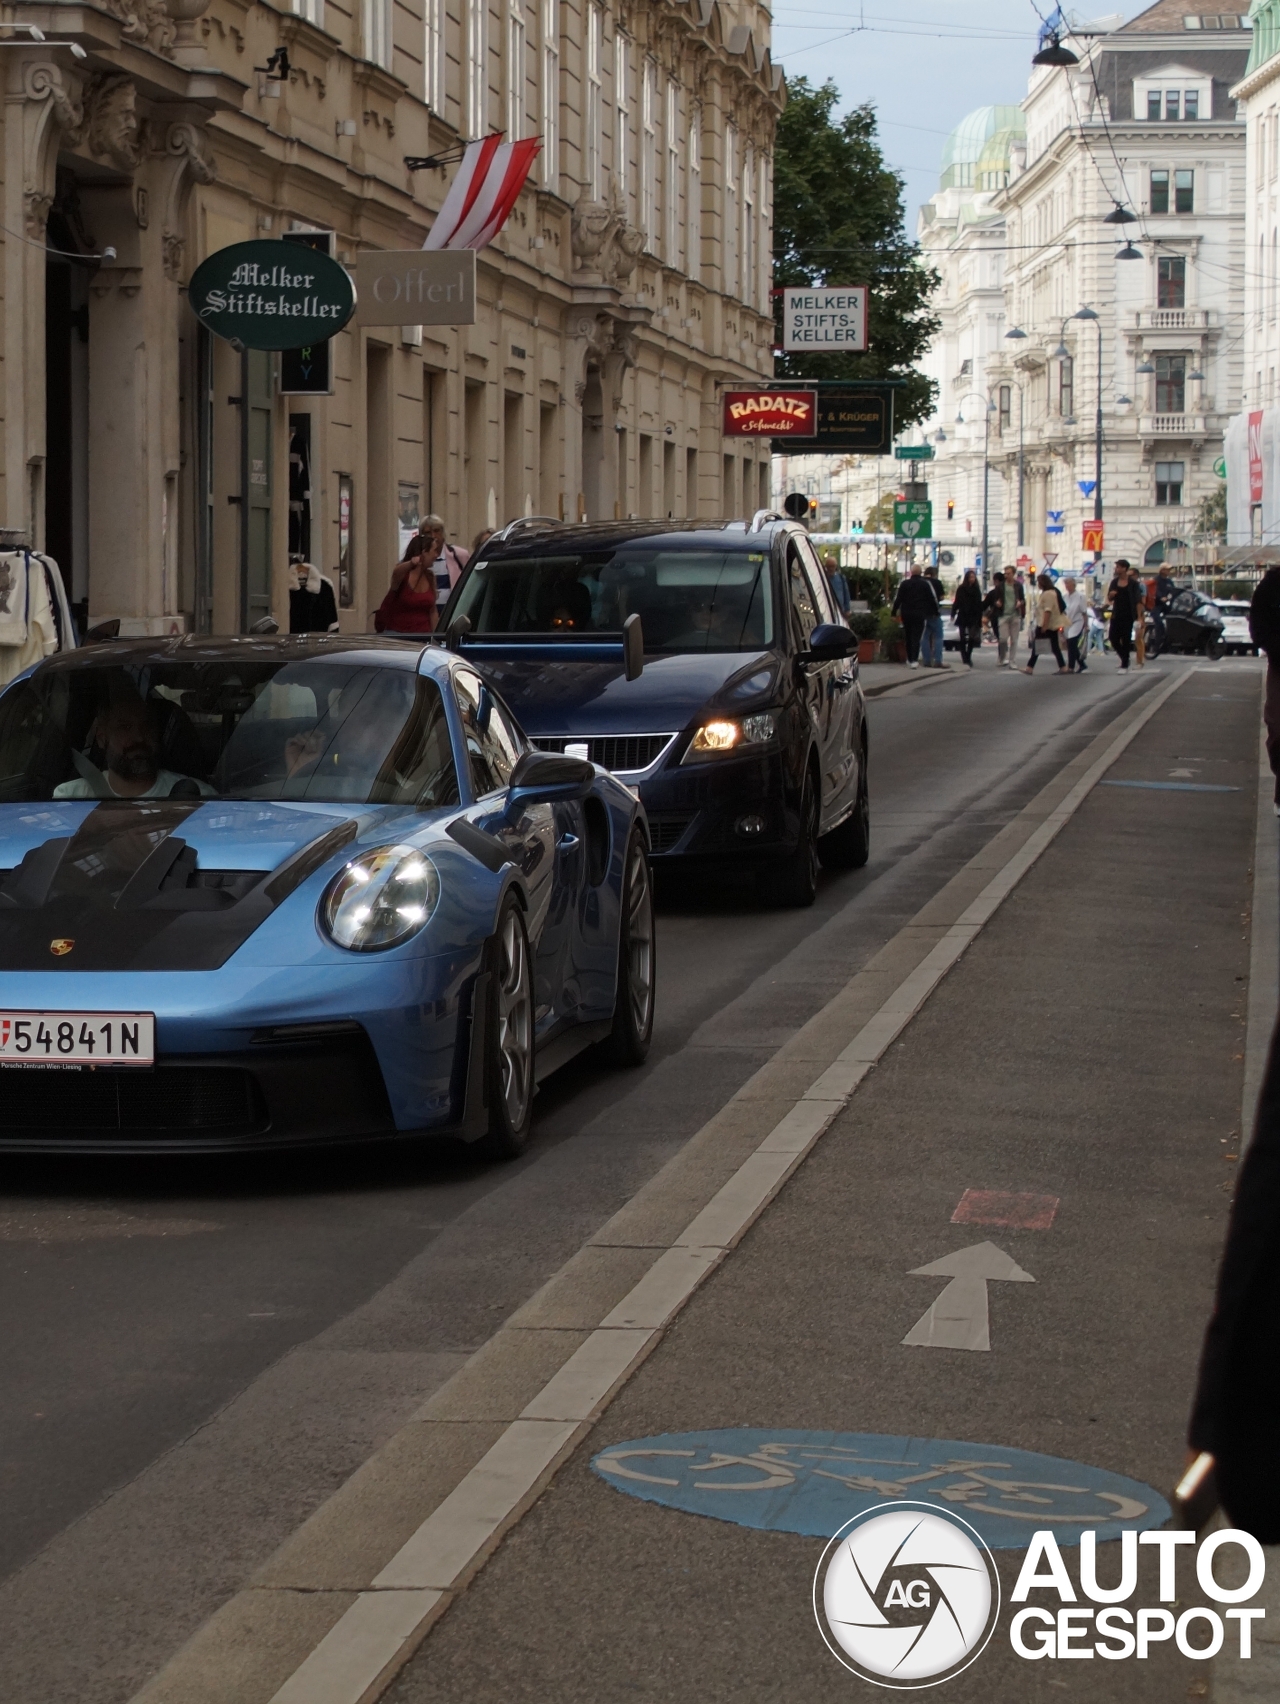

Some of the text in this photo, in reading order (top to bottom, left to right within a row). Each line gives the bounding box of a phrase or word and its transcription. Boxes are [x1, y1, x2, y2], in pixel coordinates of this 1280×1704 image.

[227, 263, 315, 291] Melker
[373, 268, 464, 303] Offerl
[200, 289, 342, 318] Stiftskeller
[790, 296, 858, 310] MELKER
[794, 314, 855, 327] STIFTS-
[792, 329, 856, 342] KELLER
[730, 396, 810, 419] RADATZ
[14, 1021, 139, 1054] 54841N
